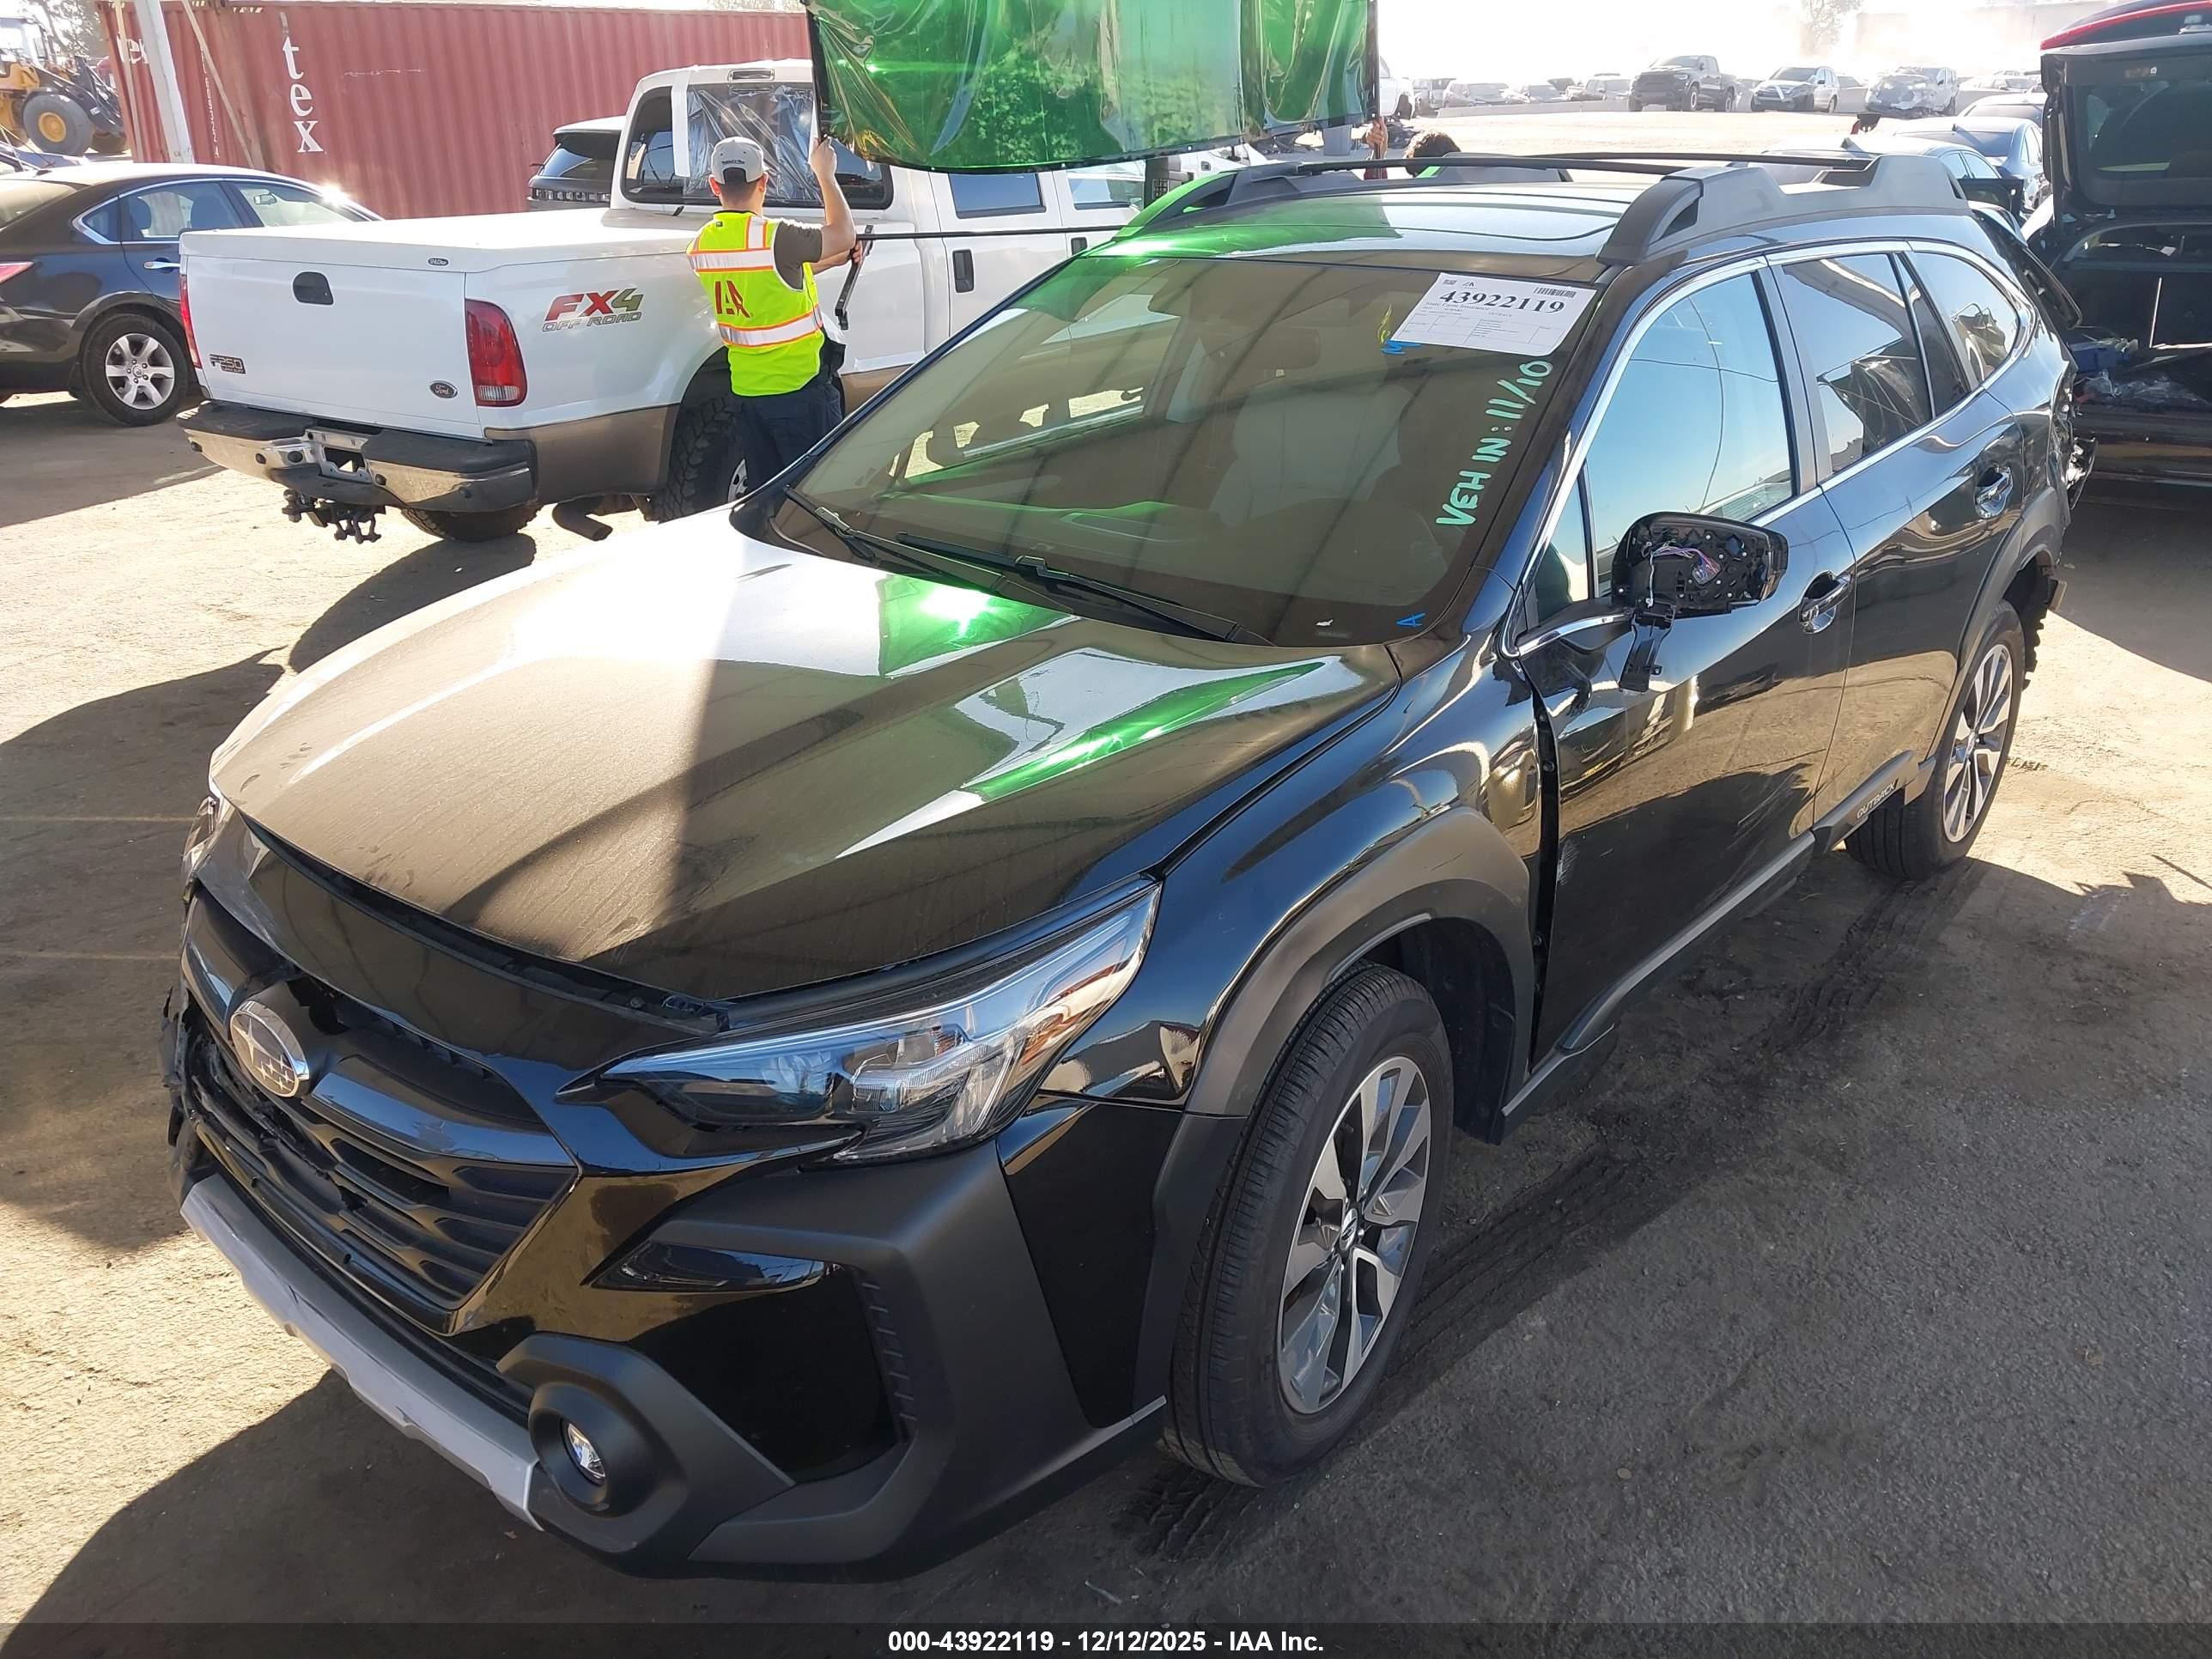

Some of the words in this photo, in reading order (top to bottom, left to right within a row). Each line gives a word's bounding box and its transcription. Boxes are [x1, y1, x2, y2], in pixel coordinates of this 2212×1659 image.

[283, 36, 323, 153] tex
[544, 288, 644, 322] FX4
[1439, 290, 1565, 313] 43922119
[542, 319, 581, 332] OFF
[586, 311, 642, 327] ROAD
[1435, 470, 1492, 526] VEH
[1485, 360, 1554, 420] 11/10
[1856, 781, 1896, 819] OUTBACK
